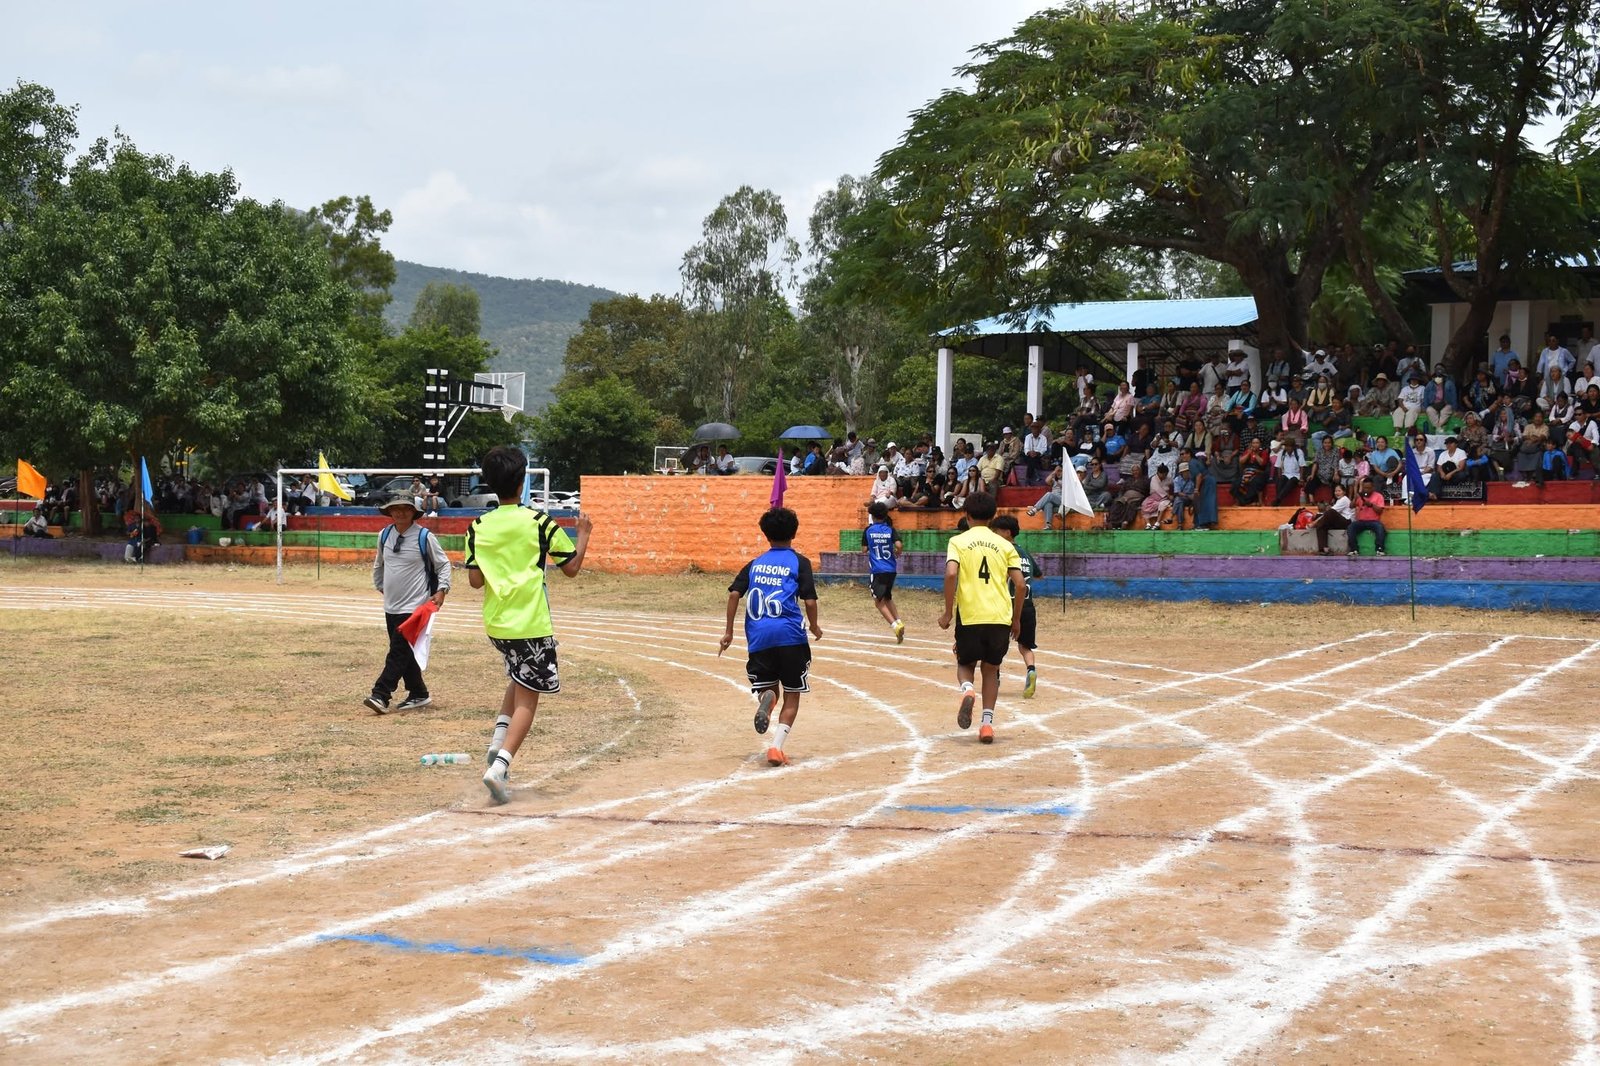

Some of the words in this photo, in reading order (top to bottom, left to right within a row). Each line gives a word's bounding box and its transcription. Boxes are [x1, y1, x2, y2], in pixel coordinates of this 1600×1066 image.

[872, 544, 892, 560] 15
[752, 564, 790, 577] TRISONG
[978, 556, 991, 584] 4
[754, 575, 782, 587] HOUSE
[746, 587, 783, 621] 06
